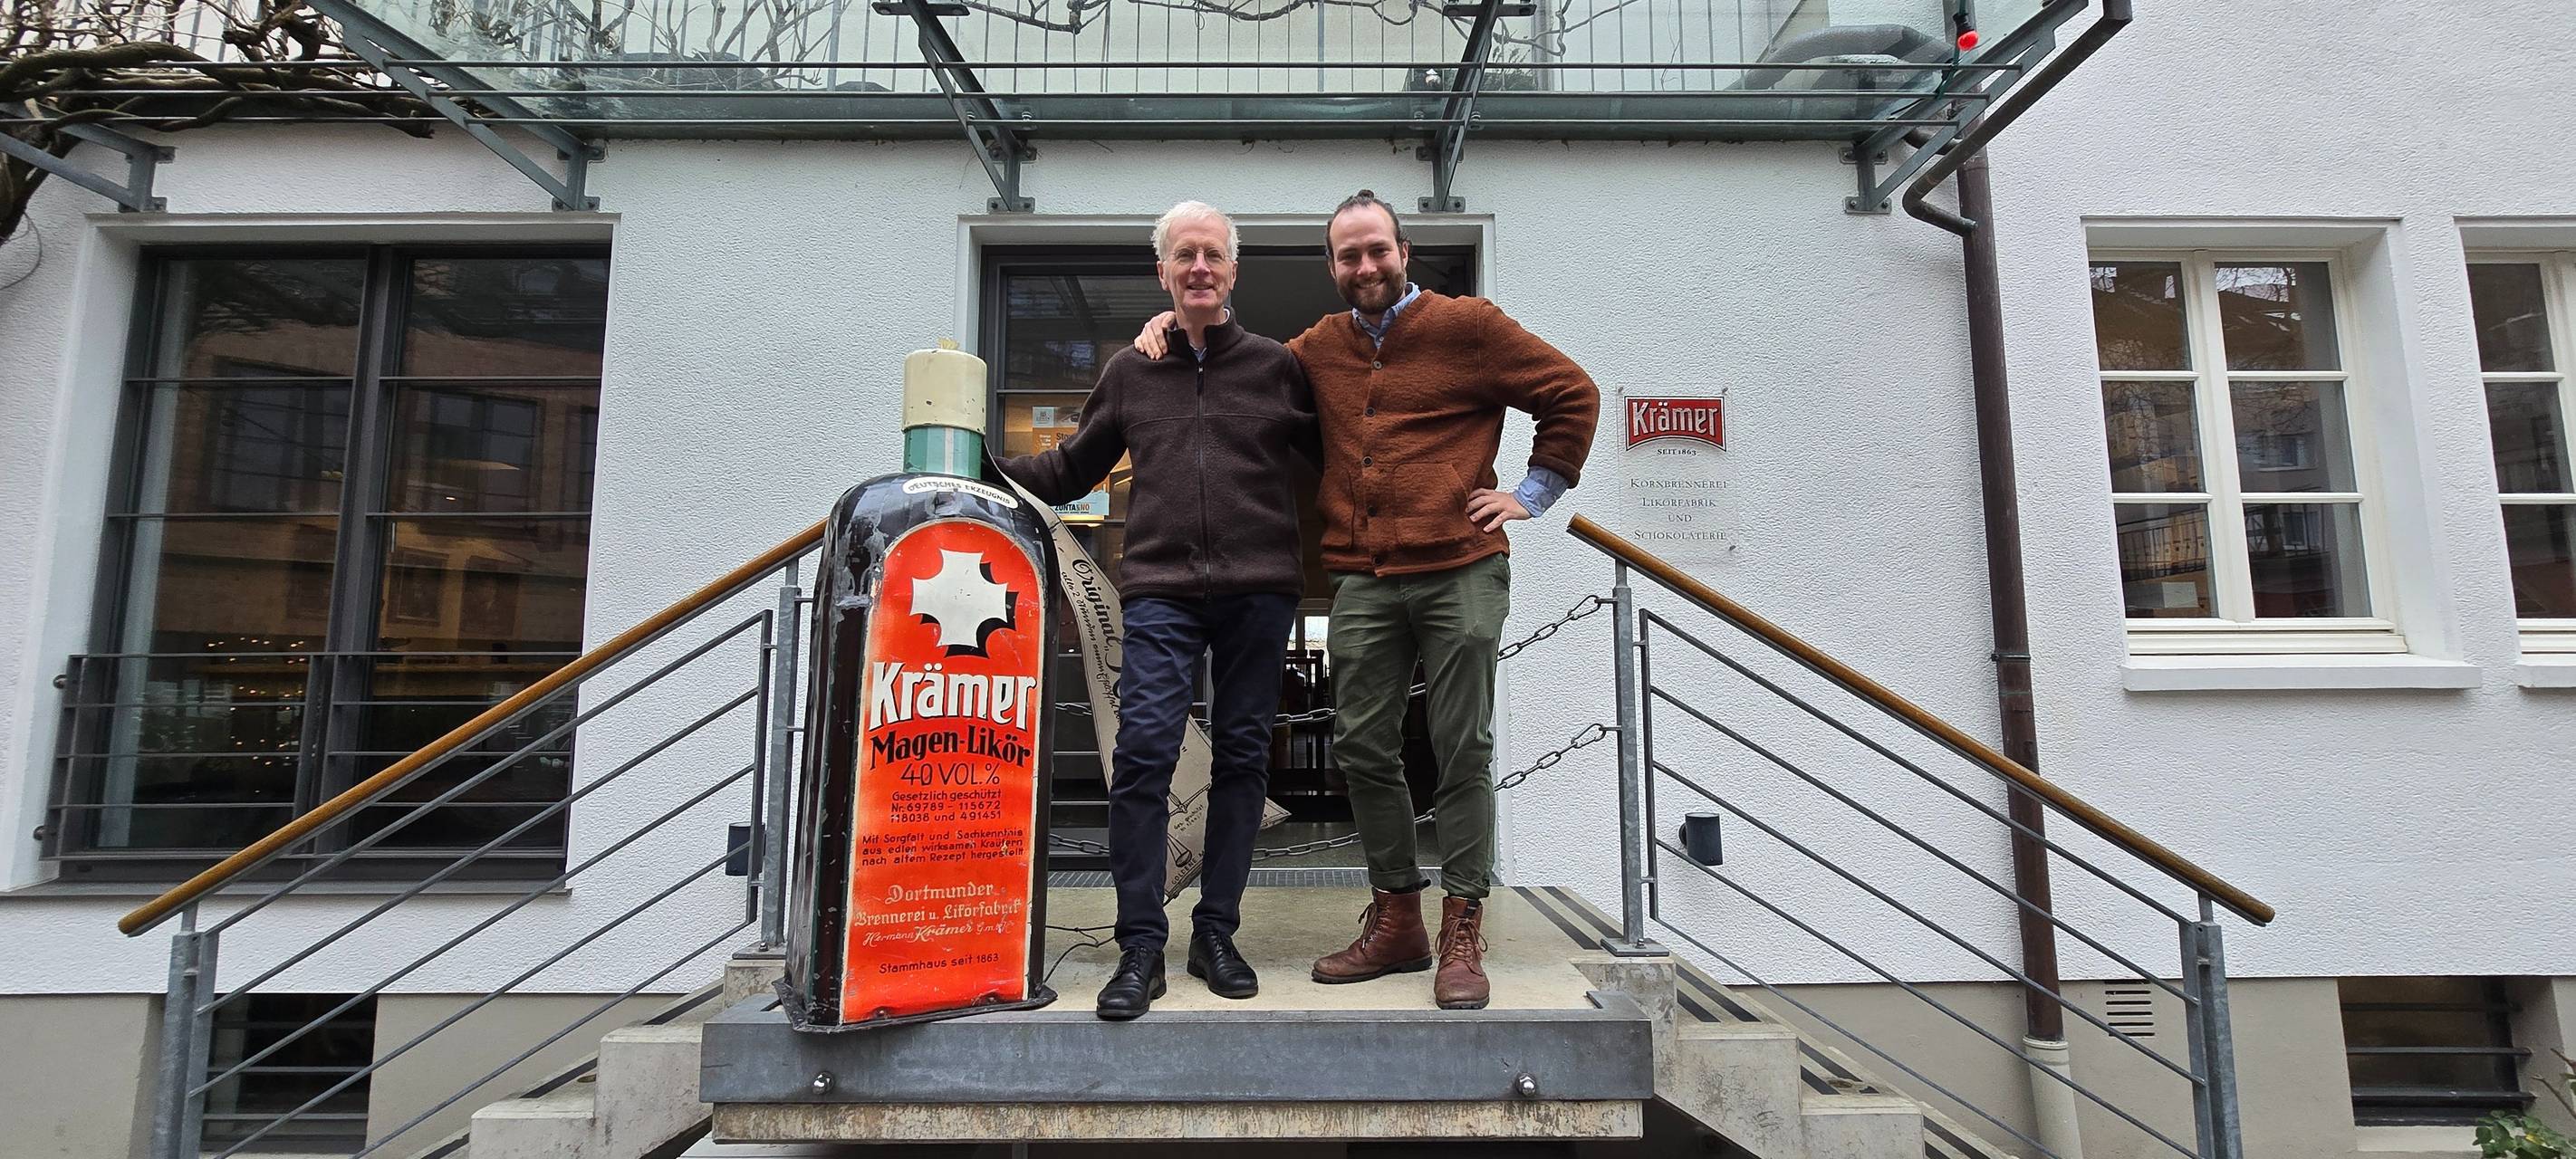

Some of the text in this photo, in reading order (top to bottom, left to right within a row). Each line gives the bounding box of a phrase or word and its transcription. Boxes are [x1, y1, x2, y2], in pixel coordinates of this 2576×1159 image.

[1632, 401, 1718, 437] Krämer
[908, 481, 1011, 504] DEUTSCHES ERZEUGNIS
[1630, 479, 1728, 488] KORNBRENNEREI
[1634, 530, 1726, 540] SCHOKOLATERIE
[1072, 559, 1122, 647] Original
[869, 661, 1037, 733] Krämer
[870, 725, 1031, 771] Magen-Likör
[900, 763, 933, 786] 40
[892, 790, 1001, 801] Gesetzlich geschützt
[959, 801, 1001, 809] 115672
[934, 812, 956, 821] und
[960, 811, 1001, 820] 491451
[862, 829, 1024, 845] Mit Sorgfalt und Sachkenntnis
[888, 845, 918, 855] edlen
[921, 841, 976, 852] wirksamen
[861, 857, 887, 867] nach
[893, 854, 926, 864] altem
[929, 852, 966, 862] Rezept
[1171, 858, 1197, 885] GOLDENE
[885, 881, 994, 905] Dortmunder
[854, 910, 926, 926] Brennerei
[928, 911, 939, 920] u.
[908, 922, 974, 943] Krämer
[879, 953, 999, 974] Stammhaus seit 1863
